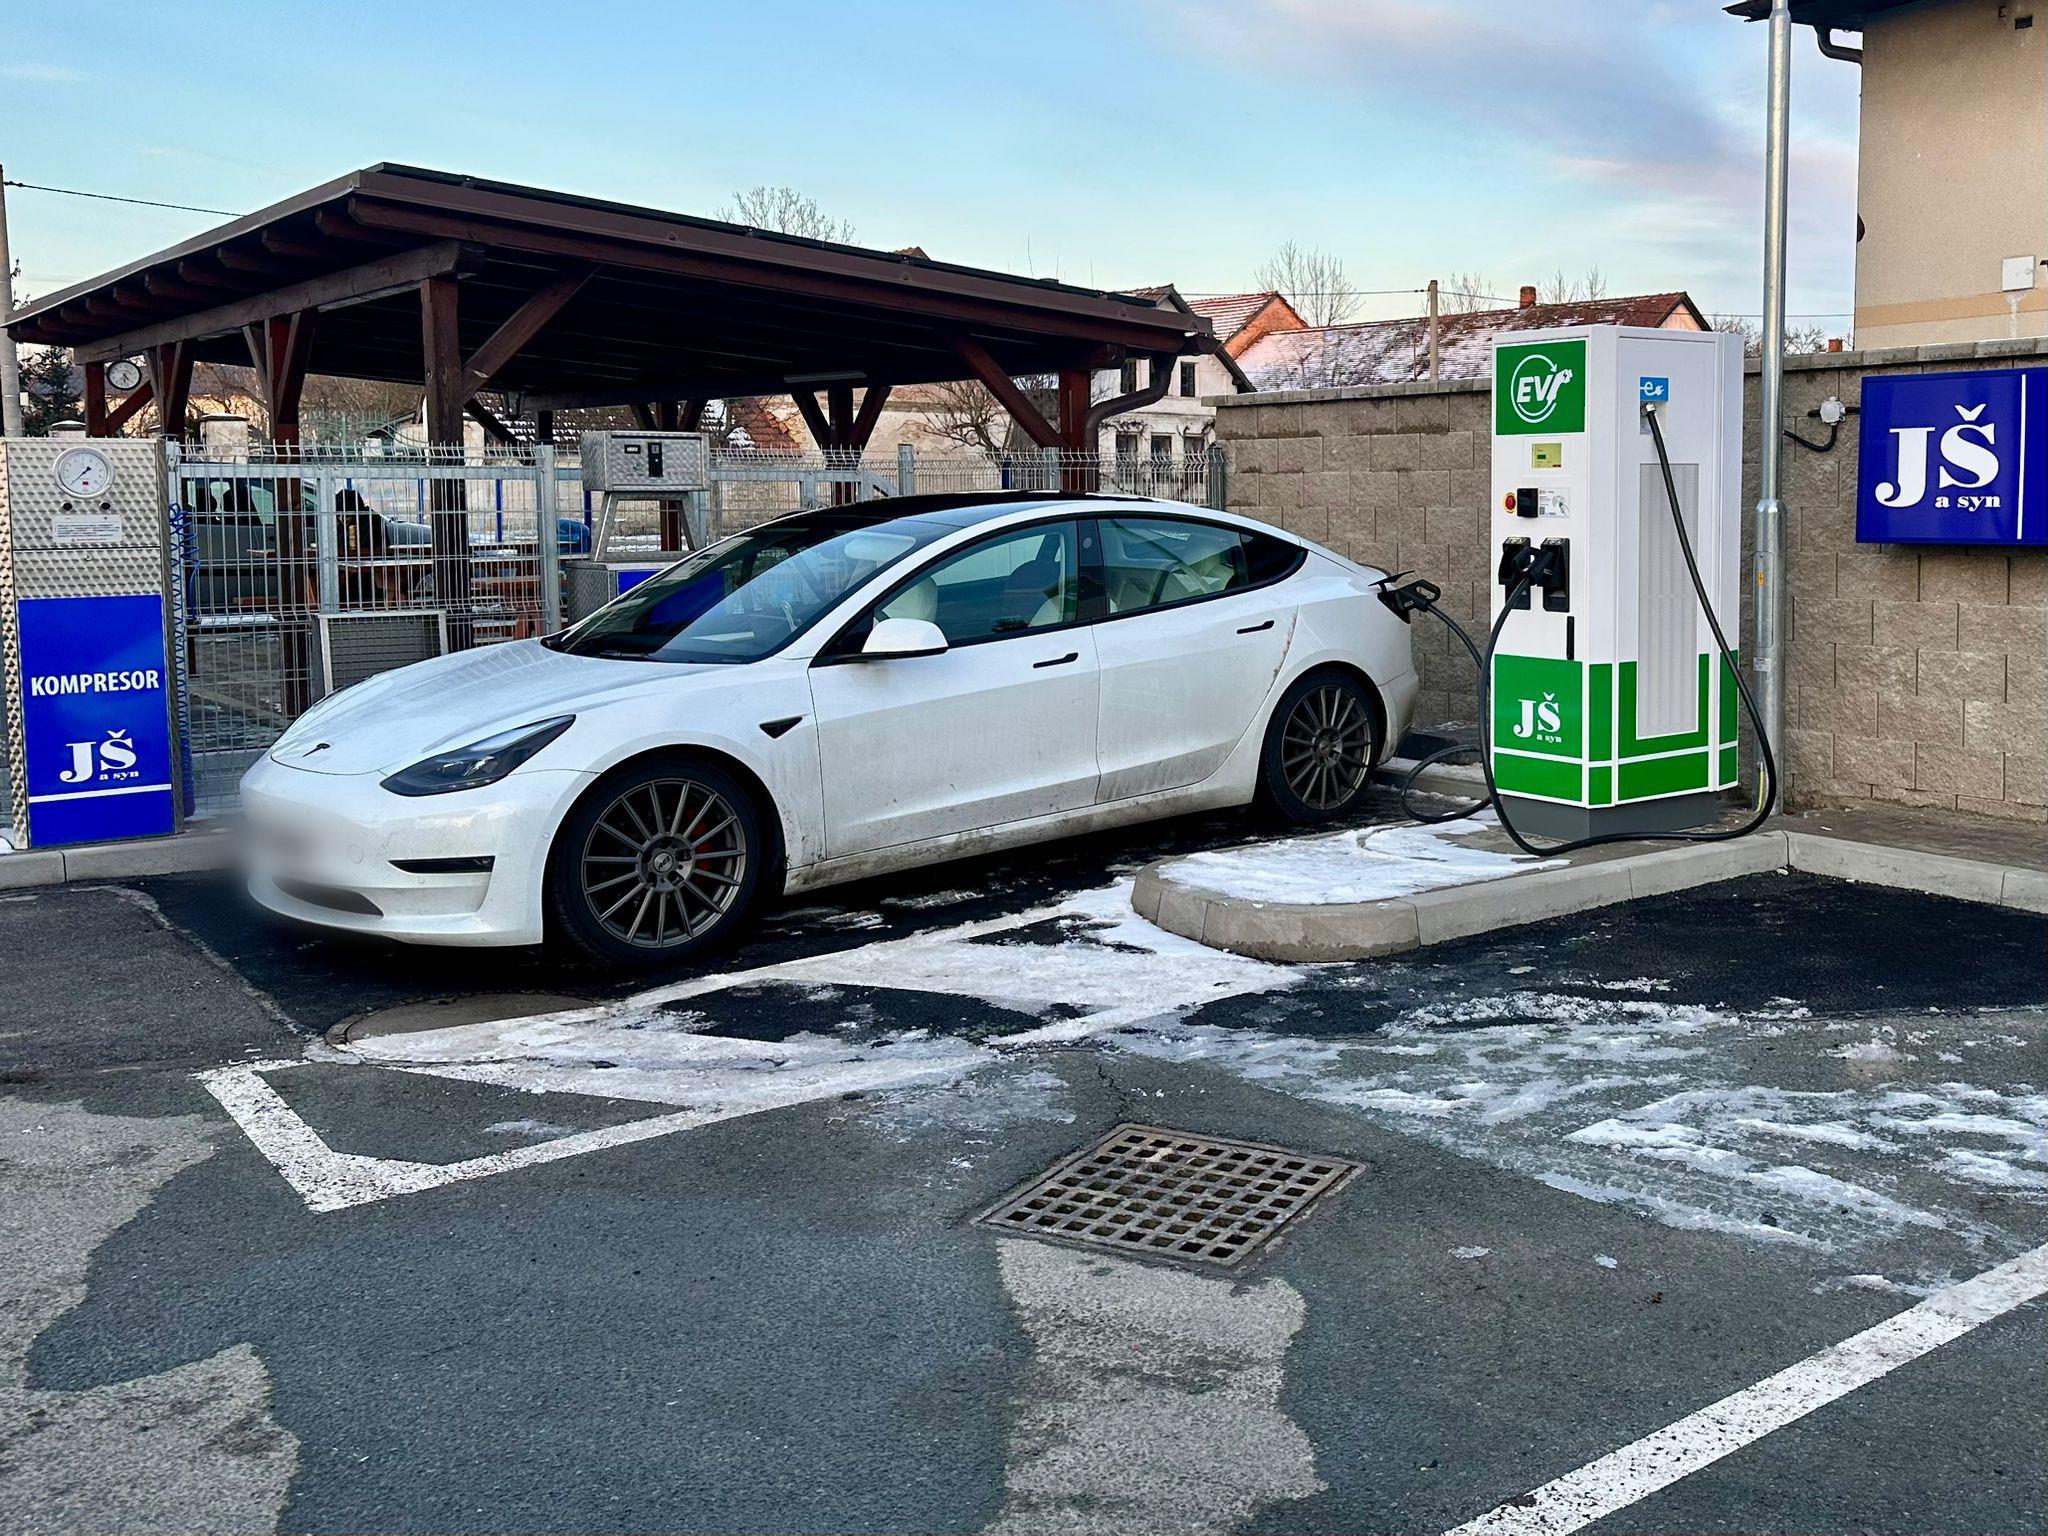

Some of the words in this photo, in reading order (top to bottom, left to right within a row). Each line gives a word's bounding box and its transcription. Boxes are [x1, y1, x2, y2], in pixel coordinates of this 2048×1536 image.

[1516, 374, 1553, 403] EV
[1874, 403, 2000, 508] JŠ
[1934, 494, 1950, 509] a
[1956, 494, 2002, 513] syn
[31, 670, 159, 696] KOMPRESOR
[1513, 691, 1561, 738] JŠ
[1545, 735, 1562, 743] syn
[59, 728, 137, 783] JŠ
[99, 773, 109, 781] a
[113, 770, 139, 781] syn
